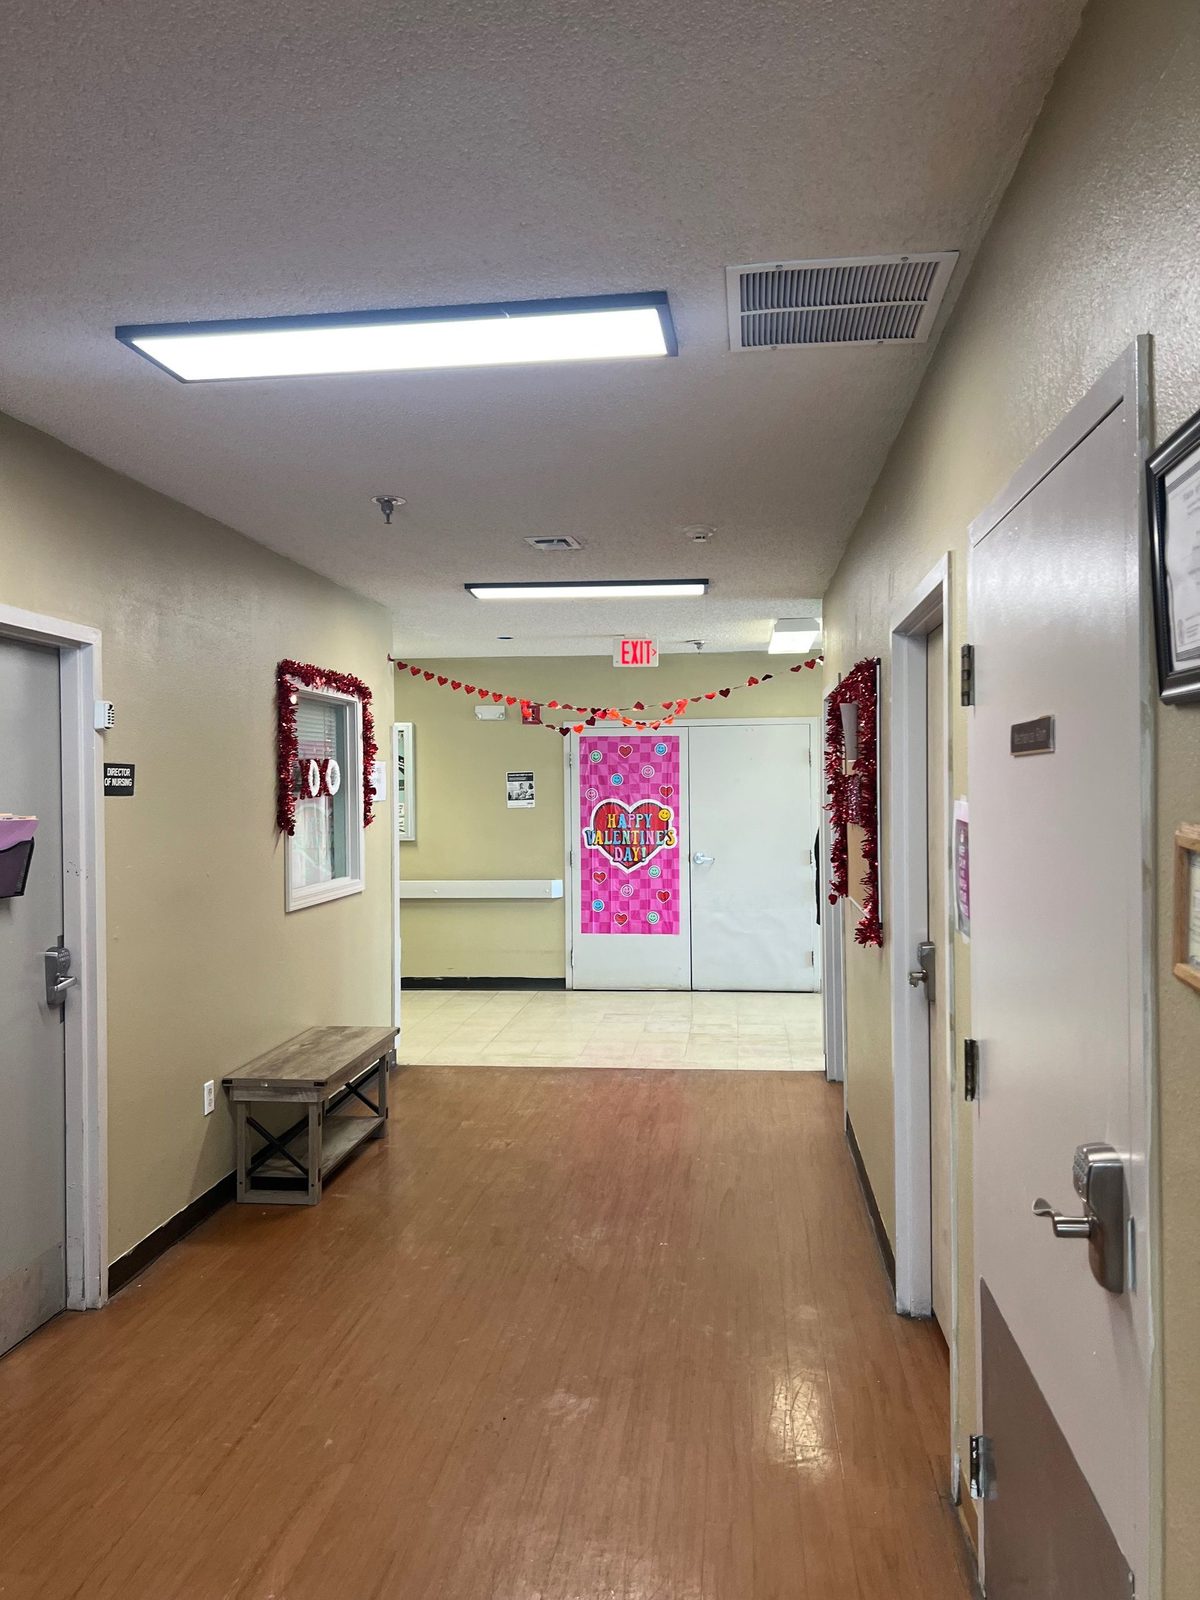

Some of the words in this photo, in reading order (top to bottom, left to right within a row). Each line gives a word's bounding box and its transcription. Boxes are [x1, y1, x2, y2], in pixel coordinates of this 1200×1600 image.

[621, 640, 652, 664] EXIT
[107, 768, 130, 776] DIRECTOR
[104, 777, 111, 786] OF
[112, 778, 132, 786] NURSING
[607, 813, 652, 829] HAPPY
[585, 829, 675, 846] VALENTINE'S
[613, 847, 647, 862] DAY!
